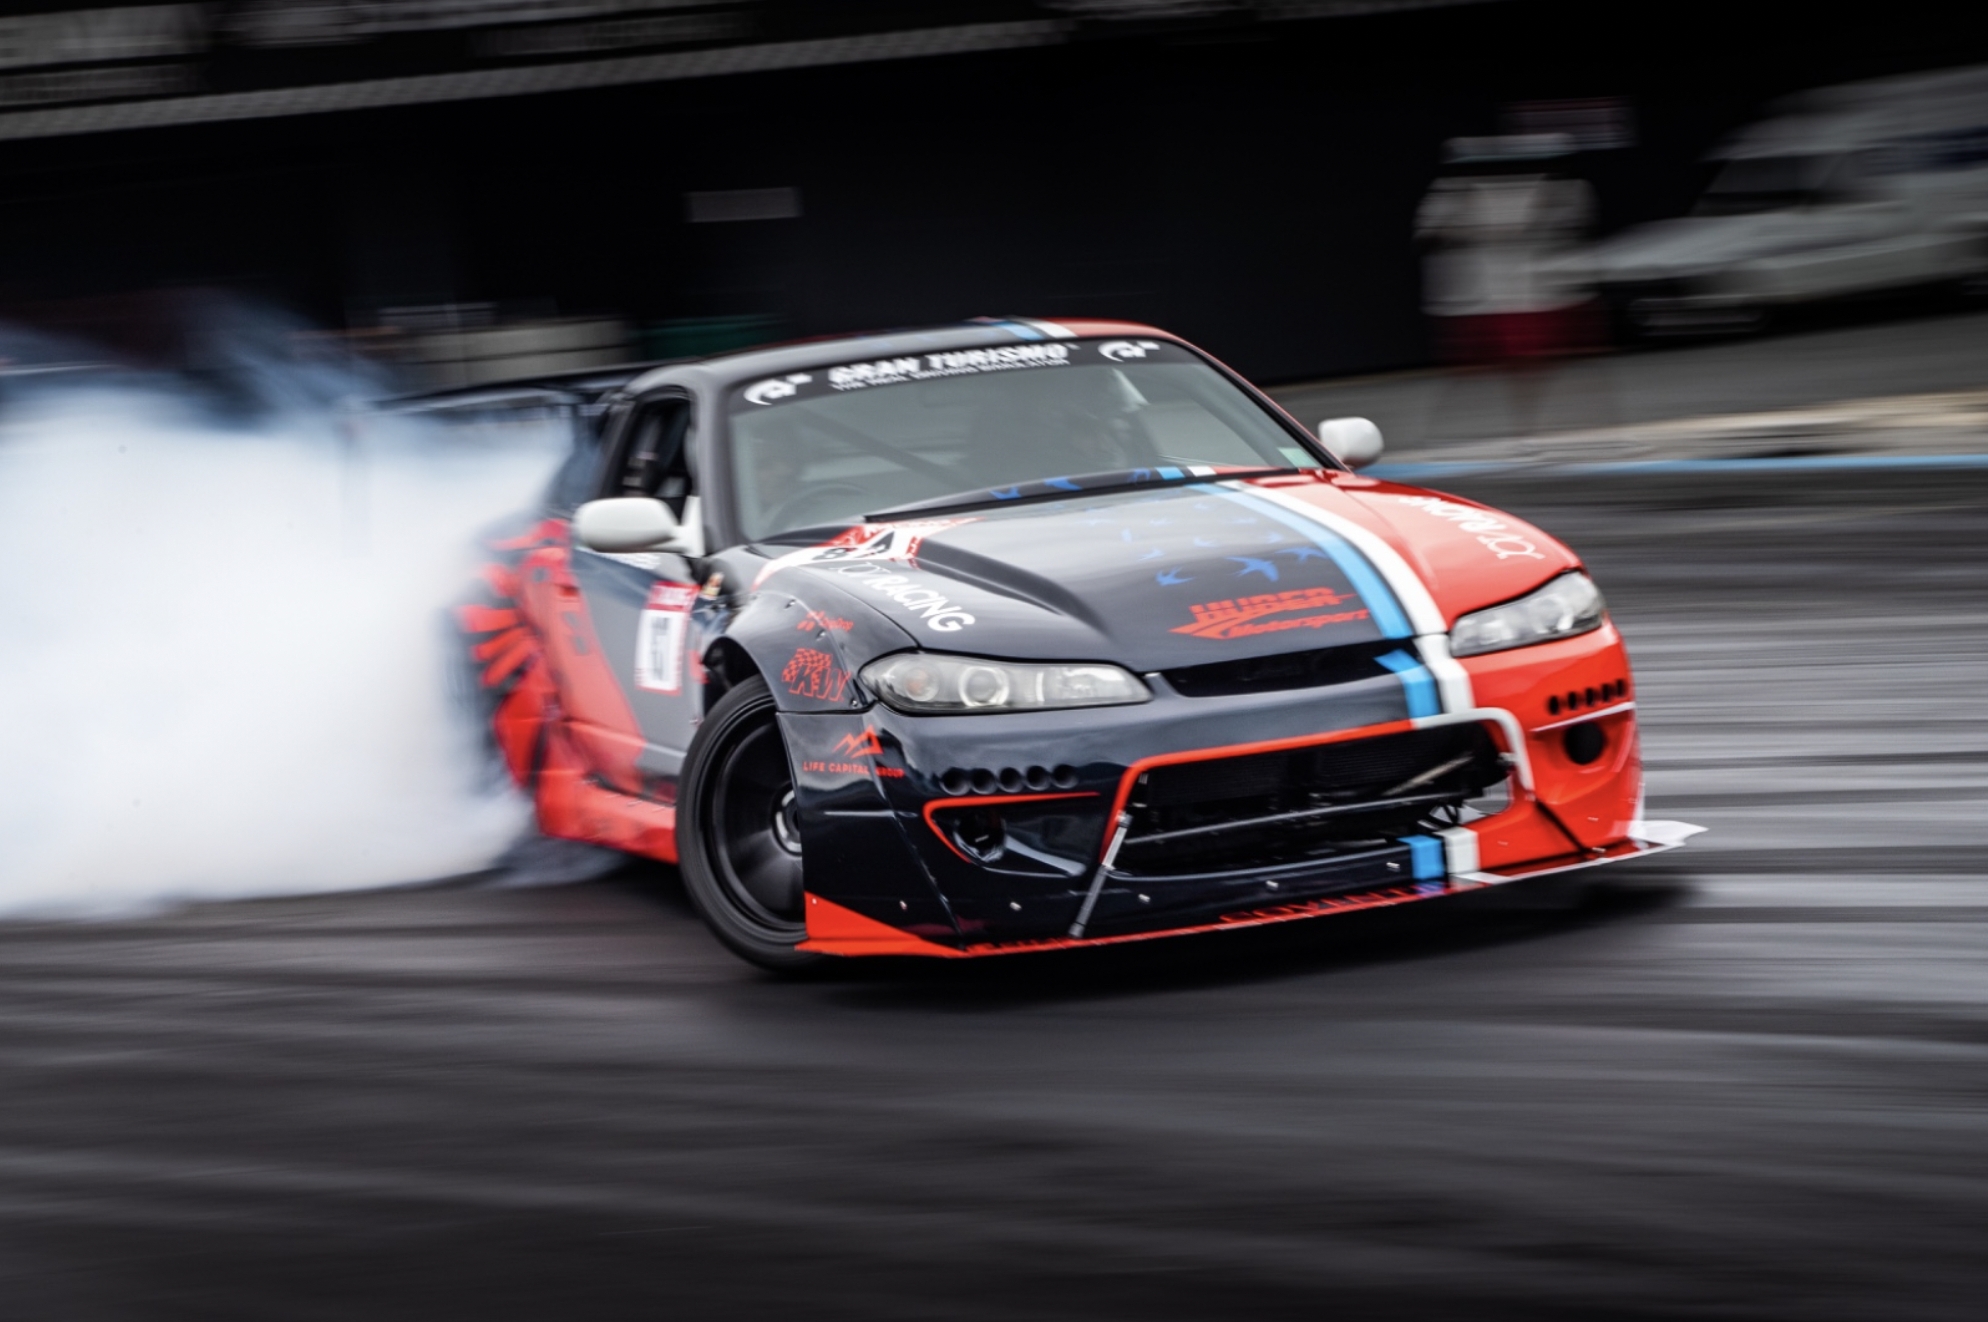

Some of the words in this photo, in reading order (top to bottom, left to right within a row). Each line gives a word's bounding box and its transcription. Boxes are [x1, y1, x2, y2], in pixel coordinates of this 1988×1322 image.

[827, 356, 920, 384] GRAN
[924, 343, 1069, 371] TURISMO
[863, 575, 976, 633] RACING
[802, 761, 826, 772] LIFE
[828, 763, 870, 775] CAPITAL
